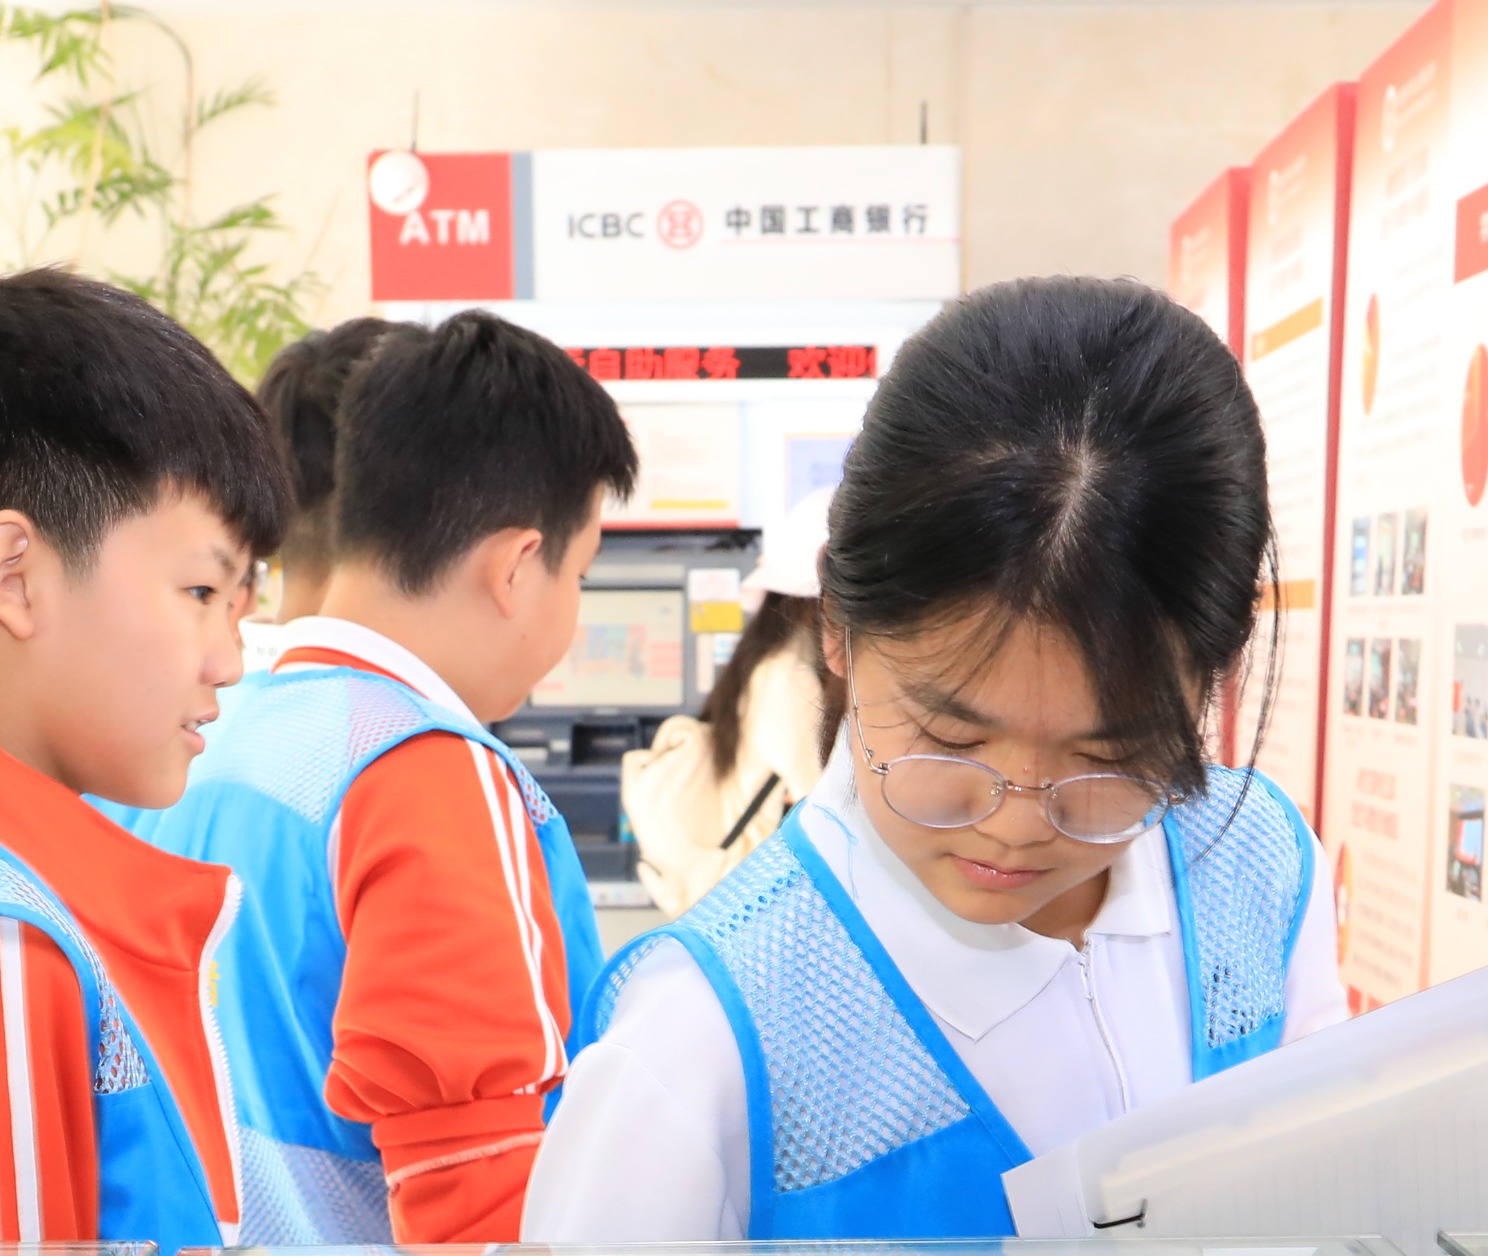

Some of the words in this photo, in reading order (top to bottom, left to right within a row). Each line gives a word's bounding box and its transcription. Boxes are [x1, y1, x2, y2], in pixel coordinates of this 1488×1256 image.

[399, 208, 490, 245] ATM
[568, 212, 645, 239] ICBC
[725, 204, 929, 236] 中国工商银行
[787, 346, 877, 380] 欢迎
